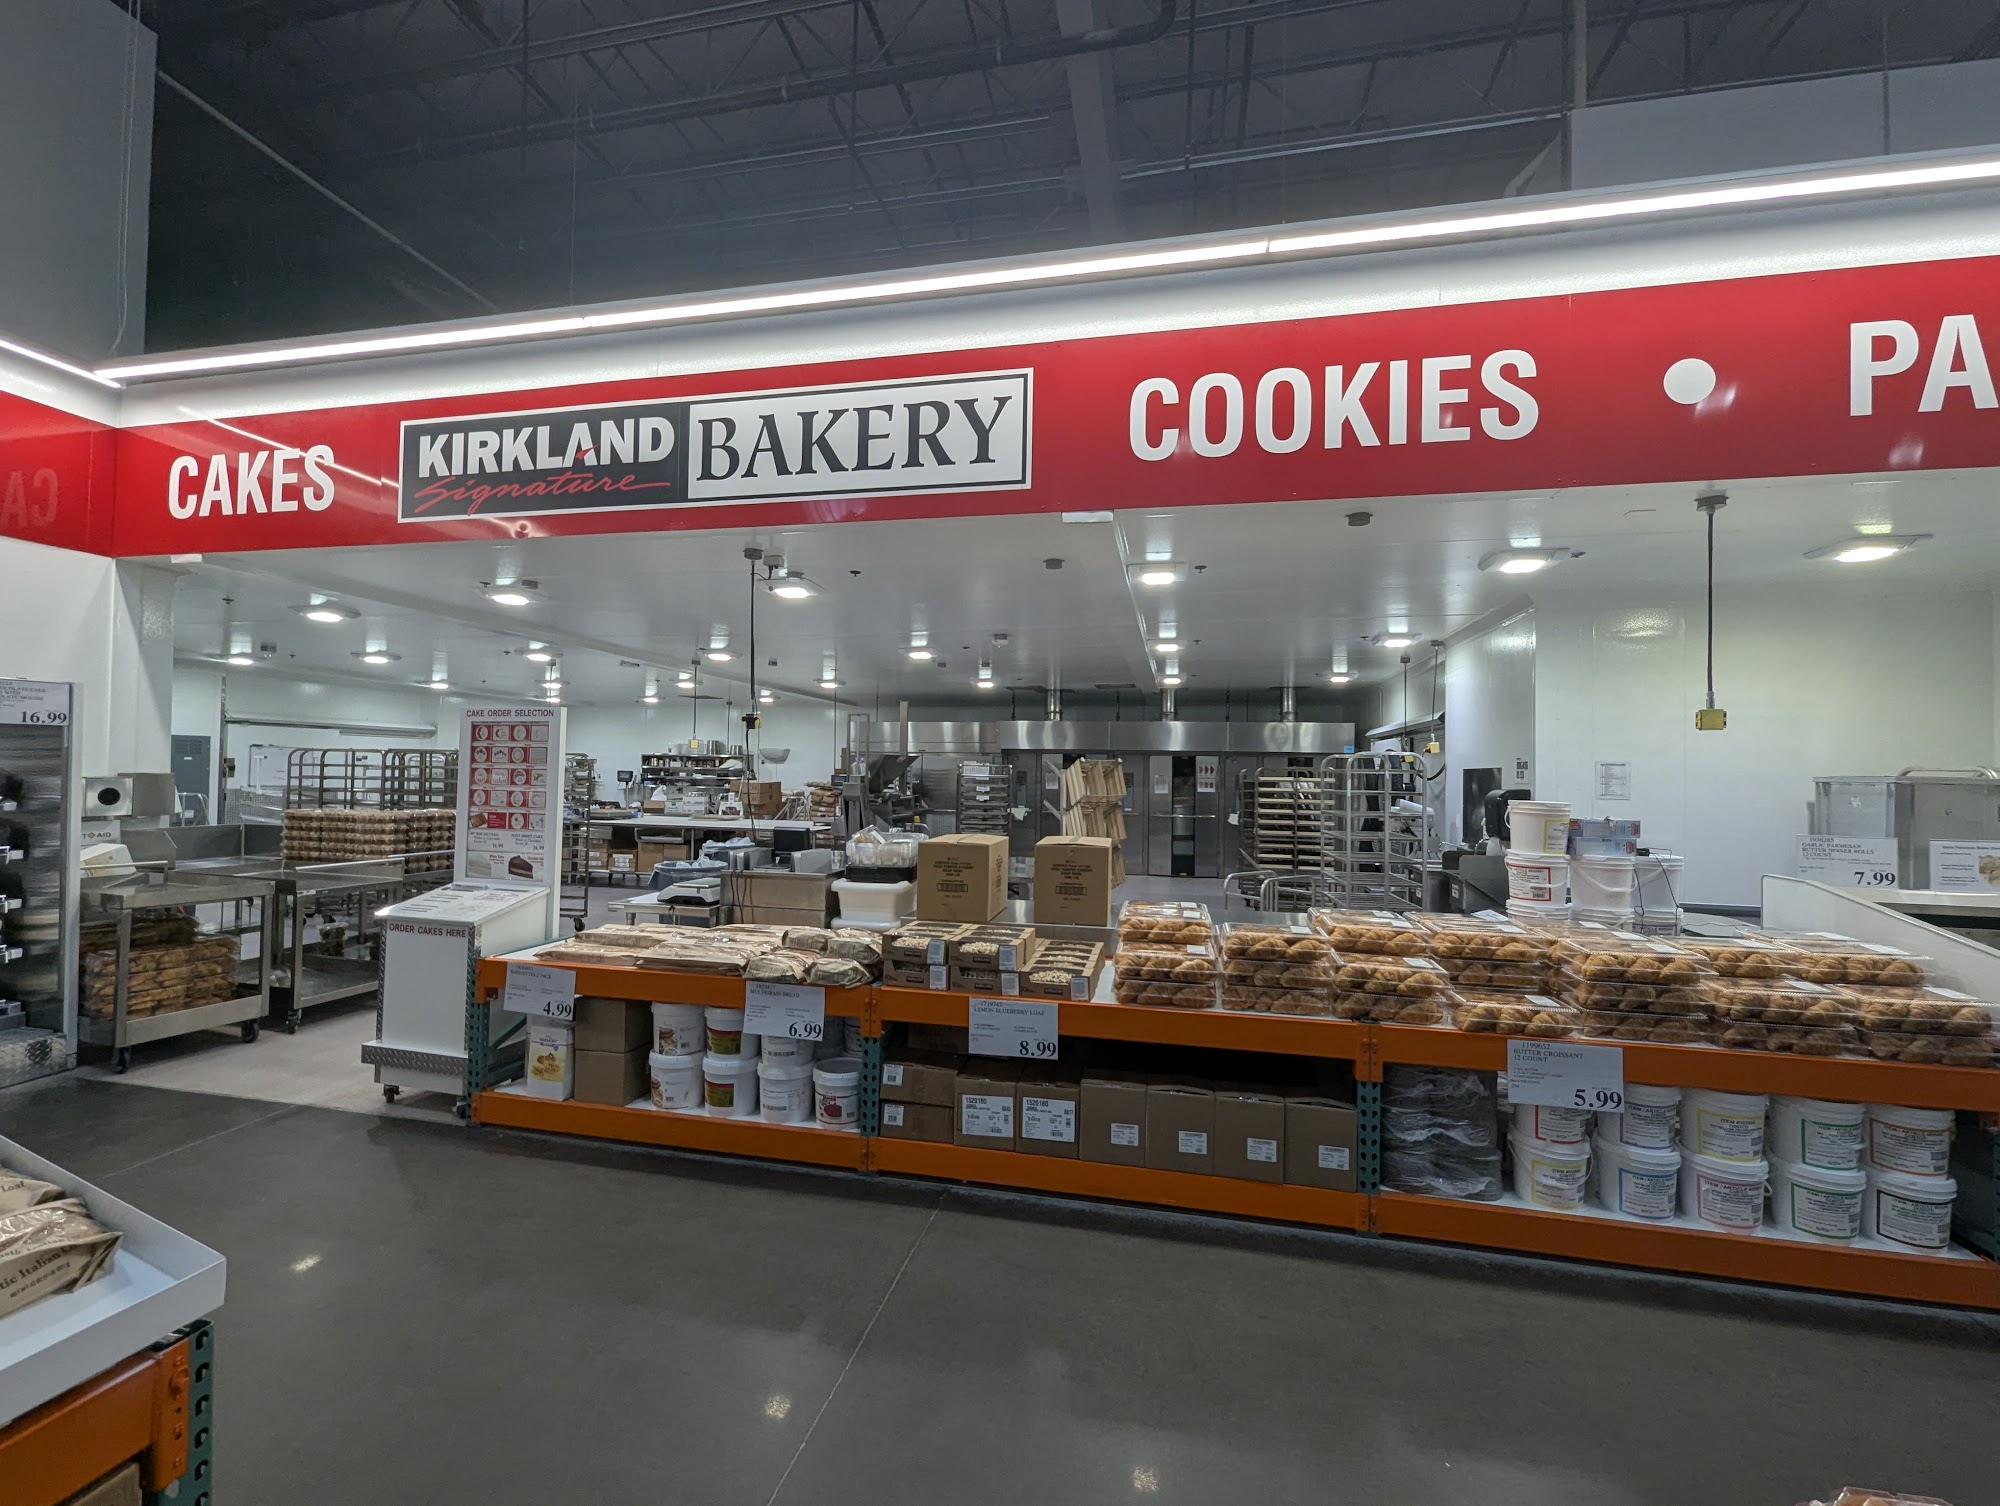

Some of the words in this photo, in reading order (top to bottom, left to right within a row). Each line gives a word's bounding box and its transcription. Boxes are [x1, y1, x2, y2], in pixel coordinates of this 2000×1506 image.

[1850, 314, 2000, 417] PA
[1129, 349, 1539, 461] COOKIES
[696, 395, 1012, 481] BAKERY
[418, 416, 675, 478] KIRKLAND
[168, 444, 335, 520] CAKES
[414, 470, 671, 517] Signature
[21, 711, 67, 724] 16.99
[466, 709, 485, 717] CAKE
[487, 709, 512, 717] ORDER
[514, 709, 555, 717] SELECTION
[1854, 872, 1896, 886] 7.99
[389, 923, 414, 933] ORDER
[417, 926, 443, 936] CAKES
[446, 929, 466, 938] HERE
[543, 1001, 572, 1018] 4.99
[995, 1007, 1028, 1015] BLUEBERRY
[789, 1021, 822, 1038] 6.99
[1019, 1040, 1056, 1057] 8.99
[1513, 1048, 1542, 1056] BUTTER
[1543, 1051, 1584, 1060] CROISSANT
[1522, 1042, 1551, 1050] 1199652
[1522, 1055, 1548, 1063] COUNT
[965, 1097, 988, 1105] 1520180
[1026, 1099, 1049, 1107] 1520180
[1574, 1088, 1622, 1109] 5.99
[1704, 1179, 1719, 1187] ITEM
[18, 1254, 62, 1279] Italian
